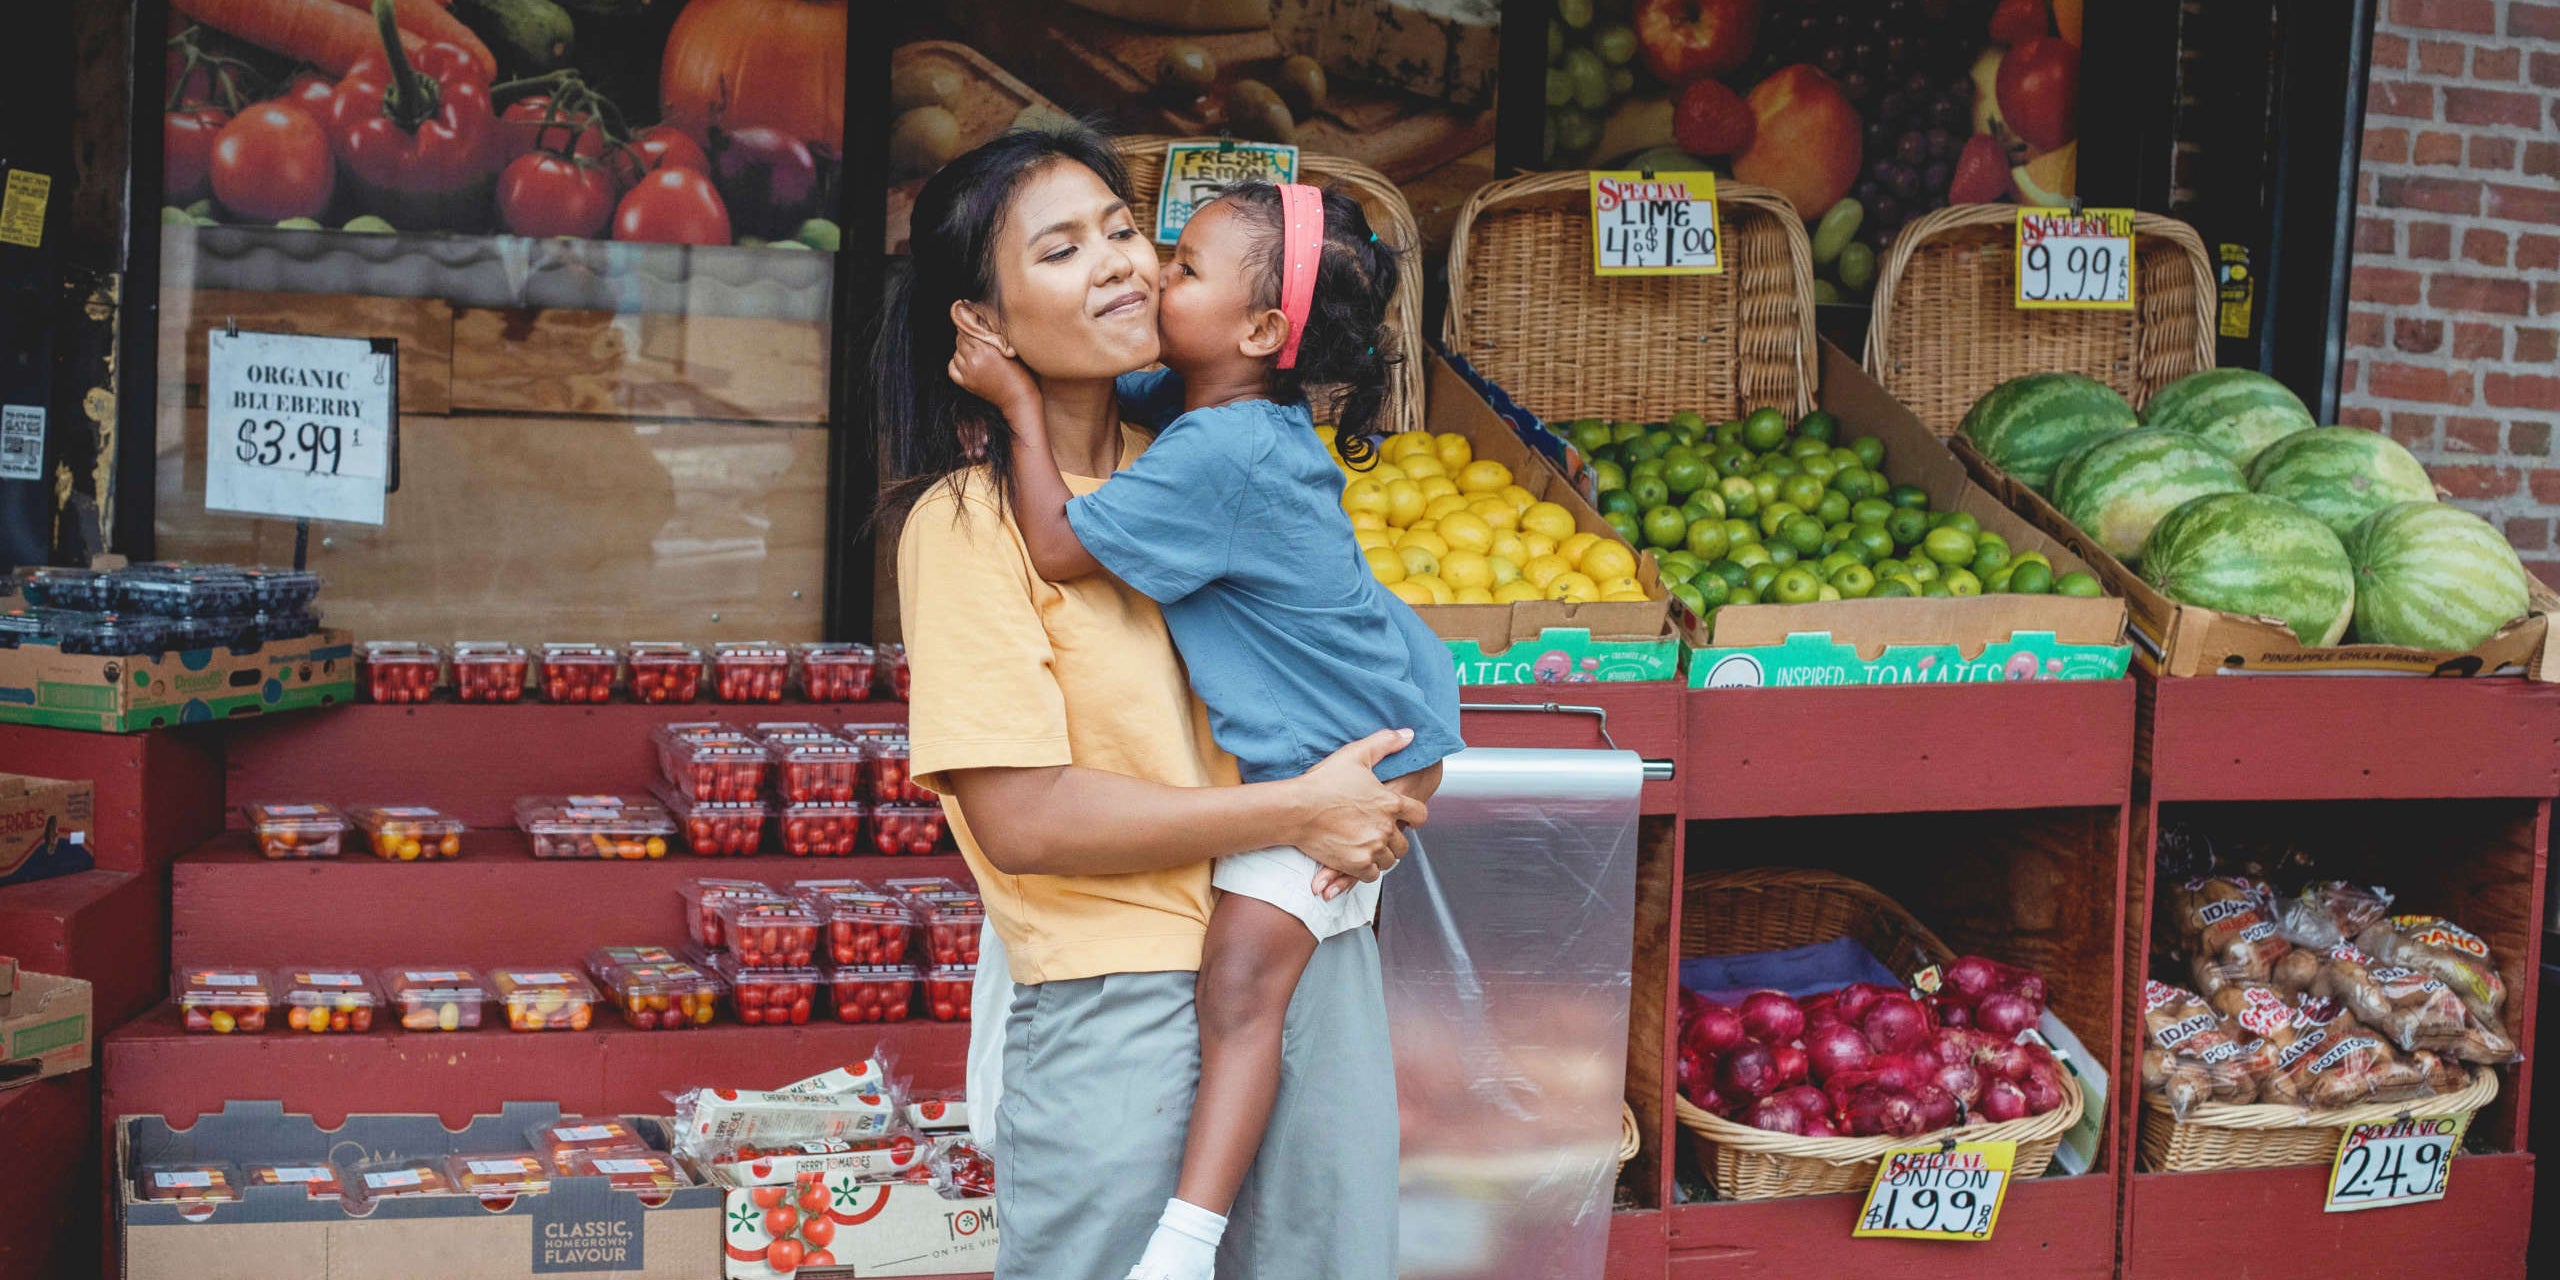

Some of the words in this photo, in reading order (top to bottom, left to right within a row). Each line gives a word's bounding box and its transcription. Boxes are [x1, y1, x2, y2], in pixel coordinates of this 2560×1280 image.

[1183, 149, 1266, 166] FRESH
[1181, 165, 1267, 181] LEMON
[1597, 178, 1692, 211] SPECIAL
[1621, 200, 1690, 226] LIME
[2025, 244, 2112, 301] 9.99
[247, 364, 350, 390] ORGANIC
[234, 391, 364, 418] BLUEBERRY
[236, 418, 342, 475] $3.99
[2260, 652, 2335, 663] PINEAPPLE
[1776, 667, 1845, 687] INSPIRED
[0, 809, 46, 834] ERRIES
[797, 1161, 823, 1172] CHERRY
[826, 1156, 871, 1170] TOMATOES
[2335, 1143, 2442, 1197] 2.49
[2434, 1150, 2451, 1194] BAG
[1891, 1169, 1990, 1189] ONION
[944, 1205, 999, 1241] TOM
[1866, 1189, 1977, 1233] $1.99
[1971, 1204, 1992, 1239] BAG
[544, 1221, 633, 1240] CLASSIC,
[544, 1238, 627, 1249] HOMEGROWN
[932, 1249, 949, 1259] ON
[954, 1243, 975, 1253] THE
[979, 1236, 999, 1247] VIN
[544, 1248, 627, 1264] FLAVOUR
